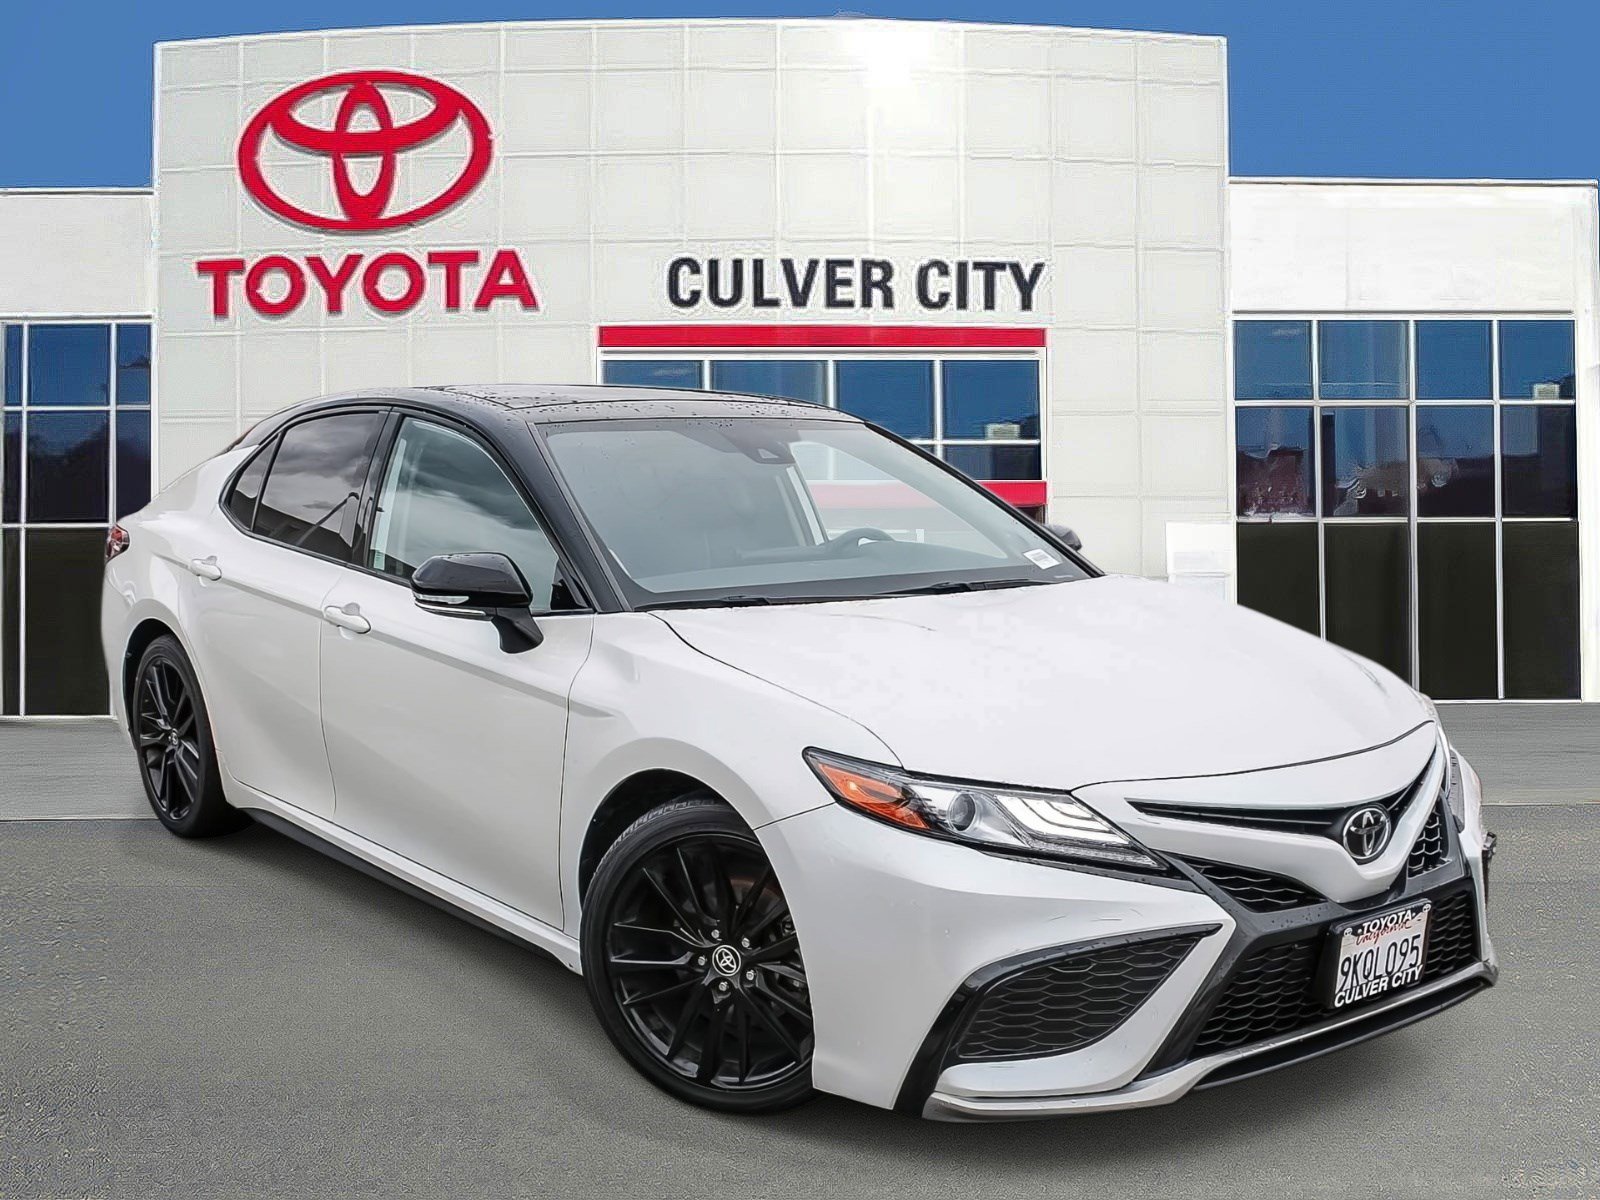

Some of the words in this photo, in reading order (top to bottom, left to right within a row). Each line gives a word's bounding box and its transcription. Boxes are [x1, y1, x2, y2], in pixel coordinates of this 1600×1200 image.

[196, 250, 539, 318] TOYOTA
[668, 257, 895, 309] CULVER
[916, 260, 1045, 311] CITY
[1362, 909, 1412, 935] TOYOTA
[1334, 976, 1389, 1008] CULVER
[1391, 964, 1423, 988] CITY
